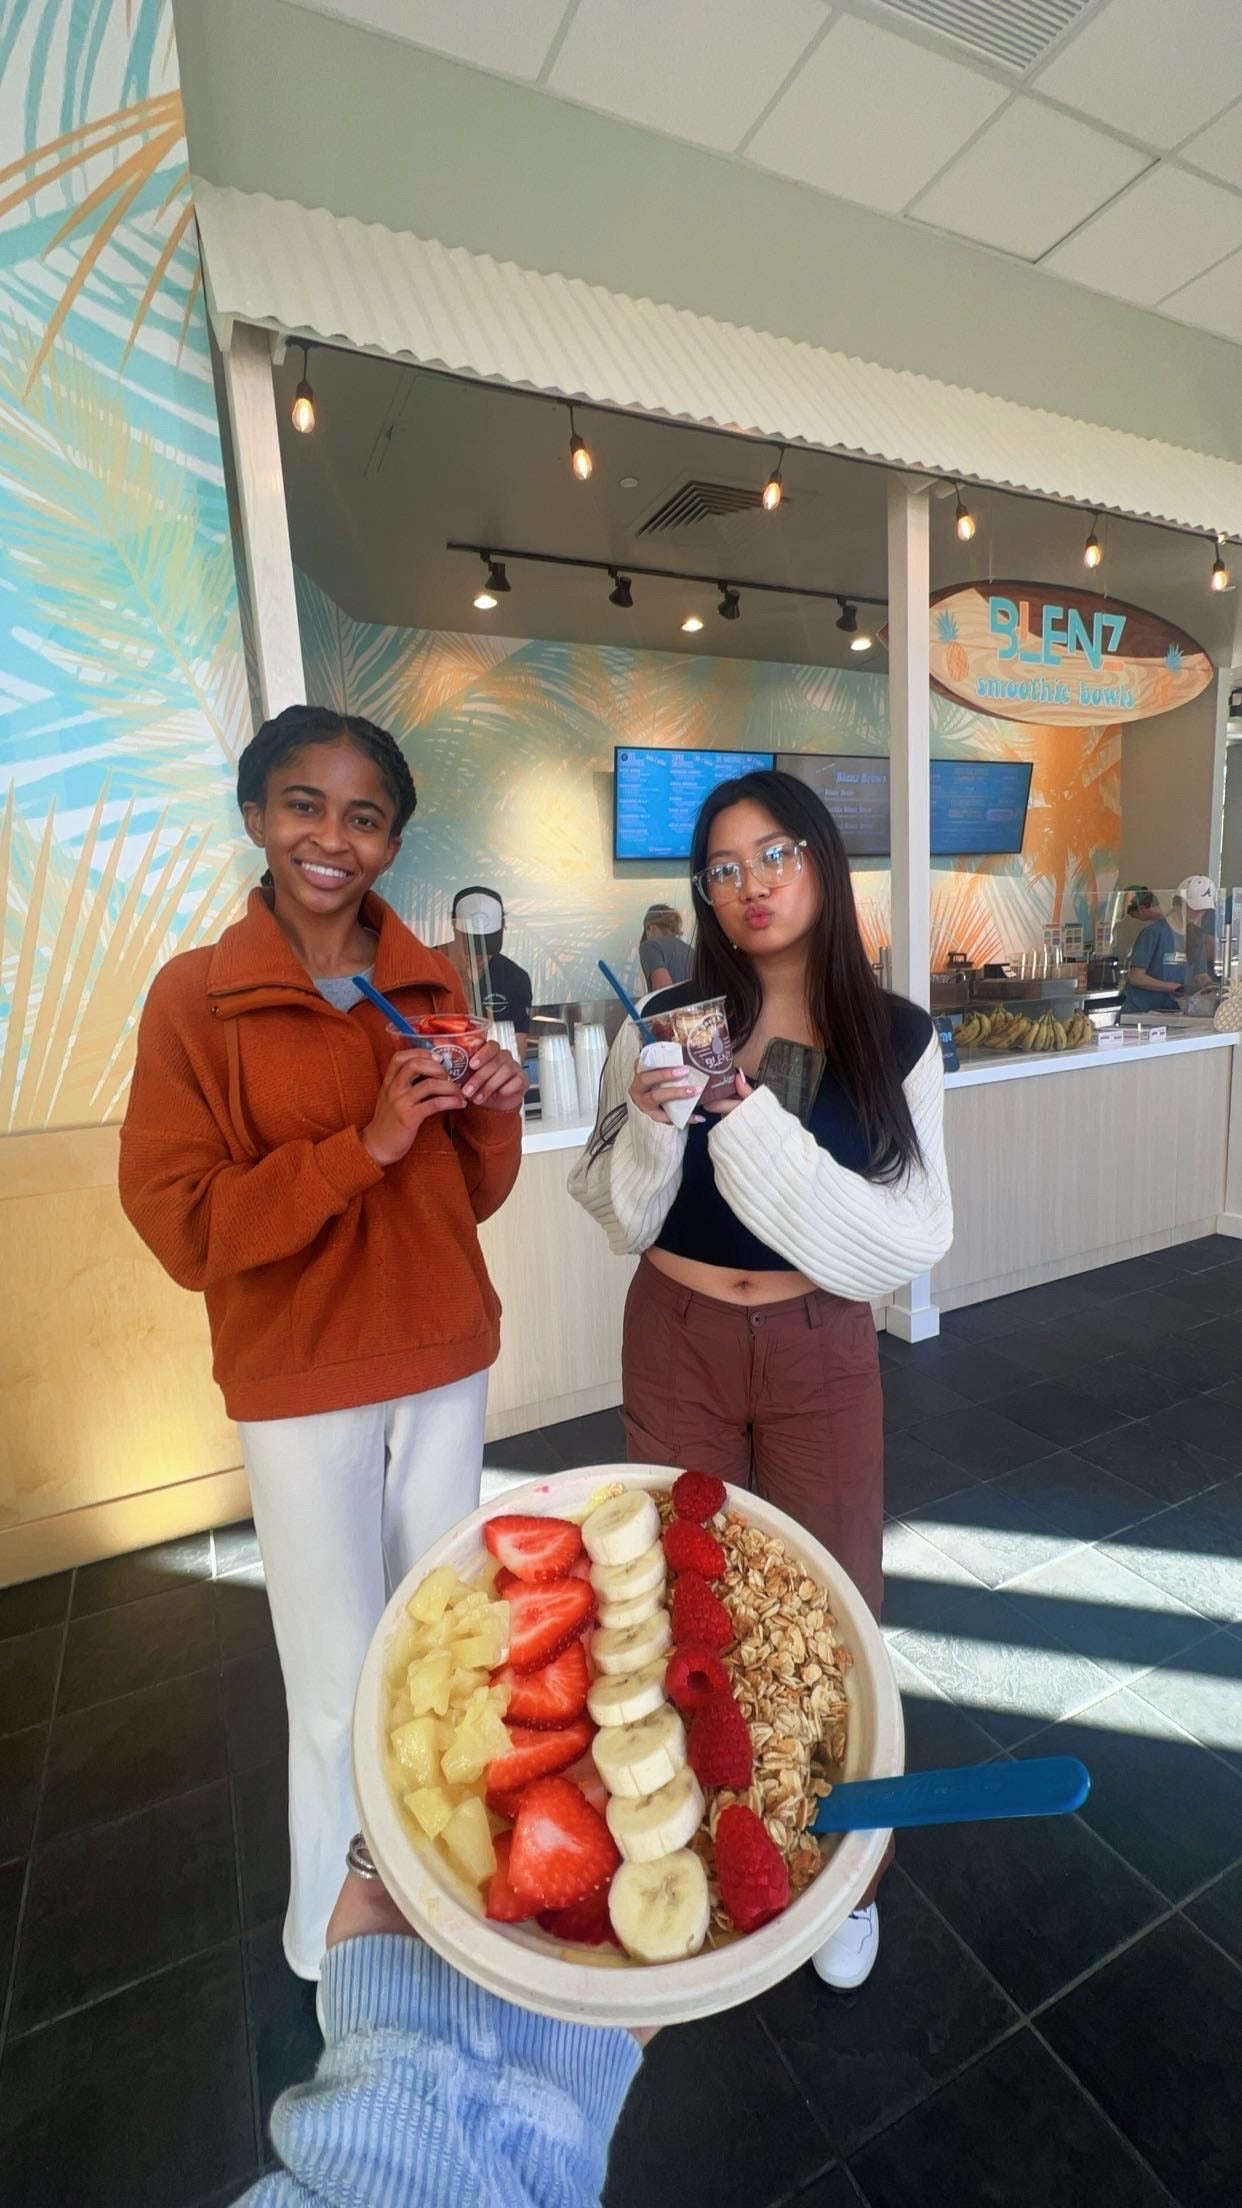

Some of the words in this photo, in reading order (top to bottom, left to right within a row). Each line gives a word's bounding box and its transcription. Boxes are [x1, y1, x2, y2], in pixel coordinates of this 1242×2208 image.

[988, 595, 1127, 672] BLENZ
[976, 676, 1071, 704] smoothie
[1079, 680, 1137, 709] bowls
